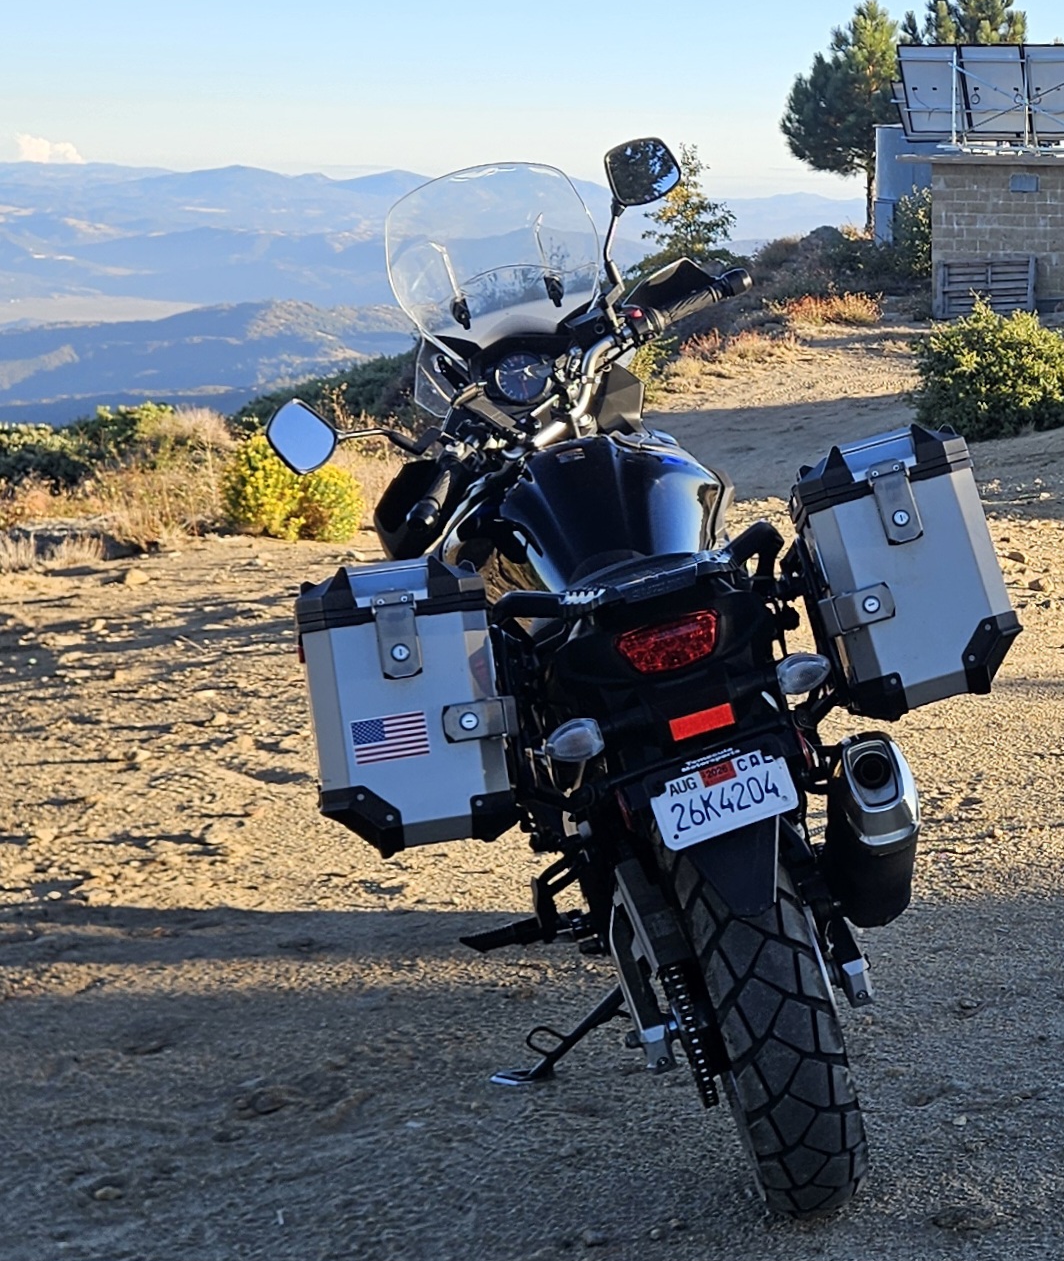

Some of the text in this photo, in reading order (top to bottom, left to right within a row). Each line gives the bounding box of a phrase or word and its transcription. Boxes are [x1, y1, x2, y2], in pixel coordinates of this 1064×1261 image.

[669, 777, 697, 797] AUG
[736, 753, 774, 772] CAL
[671, 771, 780, 833] 26K4204
